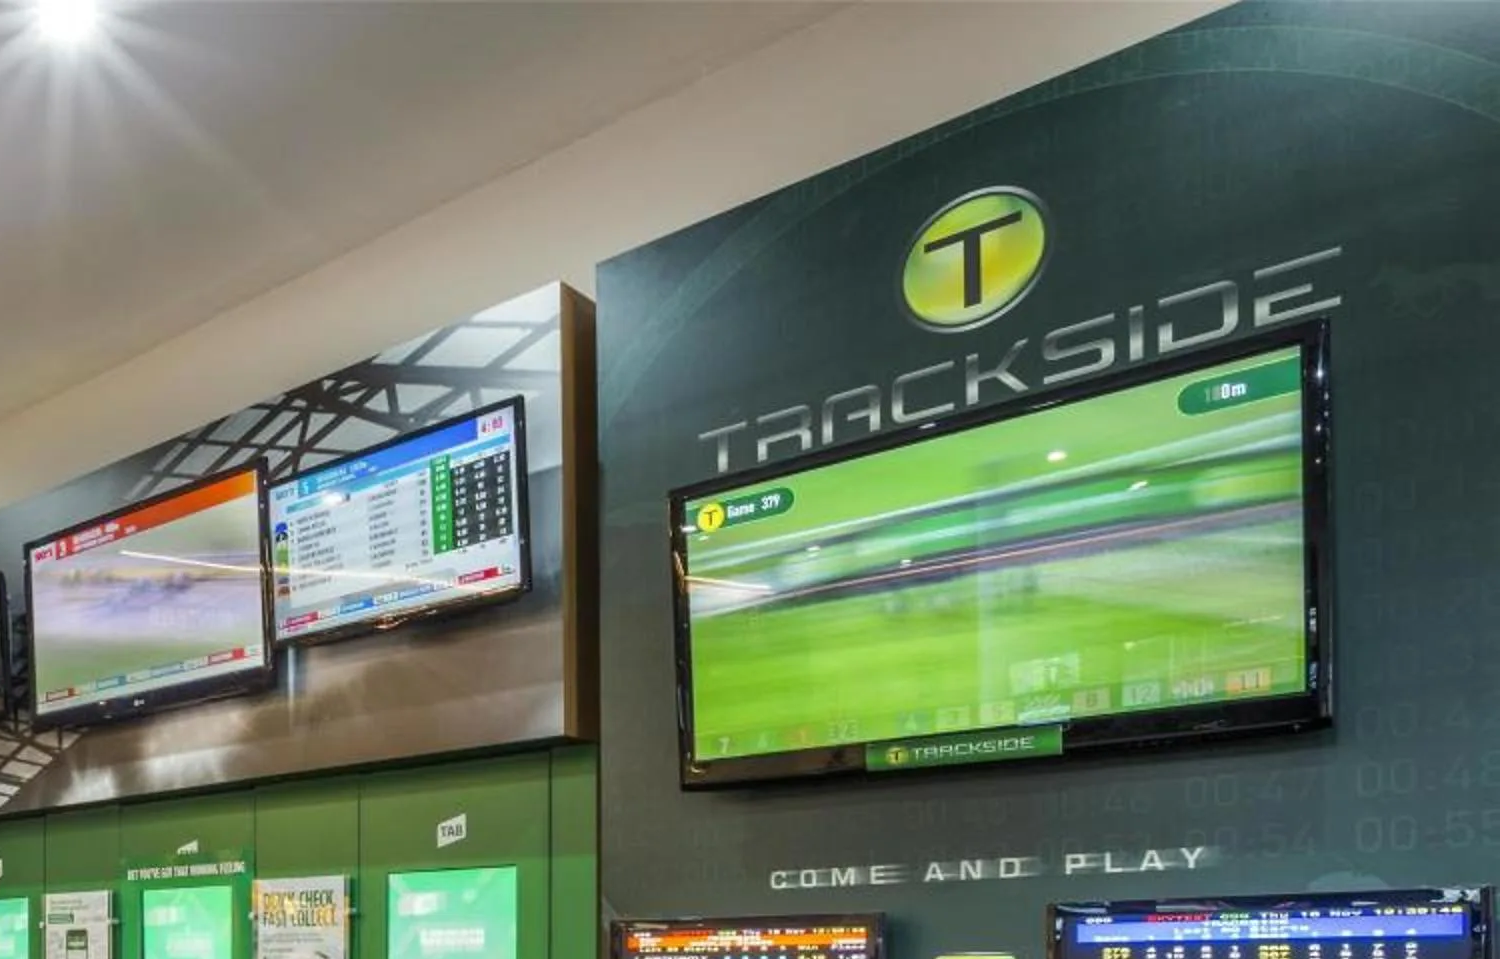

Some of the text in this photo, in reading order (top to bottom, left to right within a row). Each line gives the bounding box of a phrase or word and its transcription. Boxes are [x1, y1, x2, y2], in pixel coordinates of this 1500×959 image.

[698, 246, 1341, 474] TRACKSIDE
[912, 735, 1036, 760] TRACKSIDE
[440, 825, 464, 838] TAB
[770, 846, 1203, 890] COME AND PLAY
